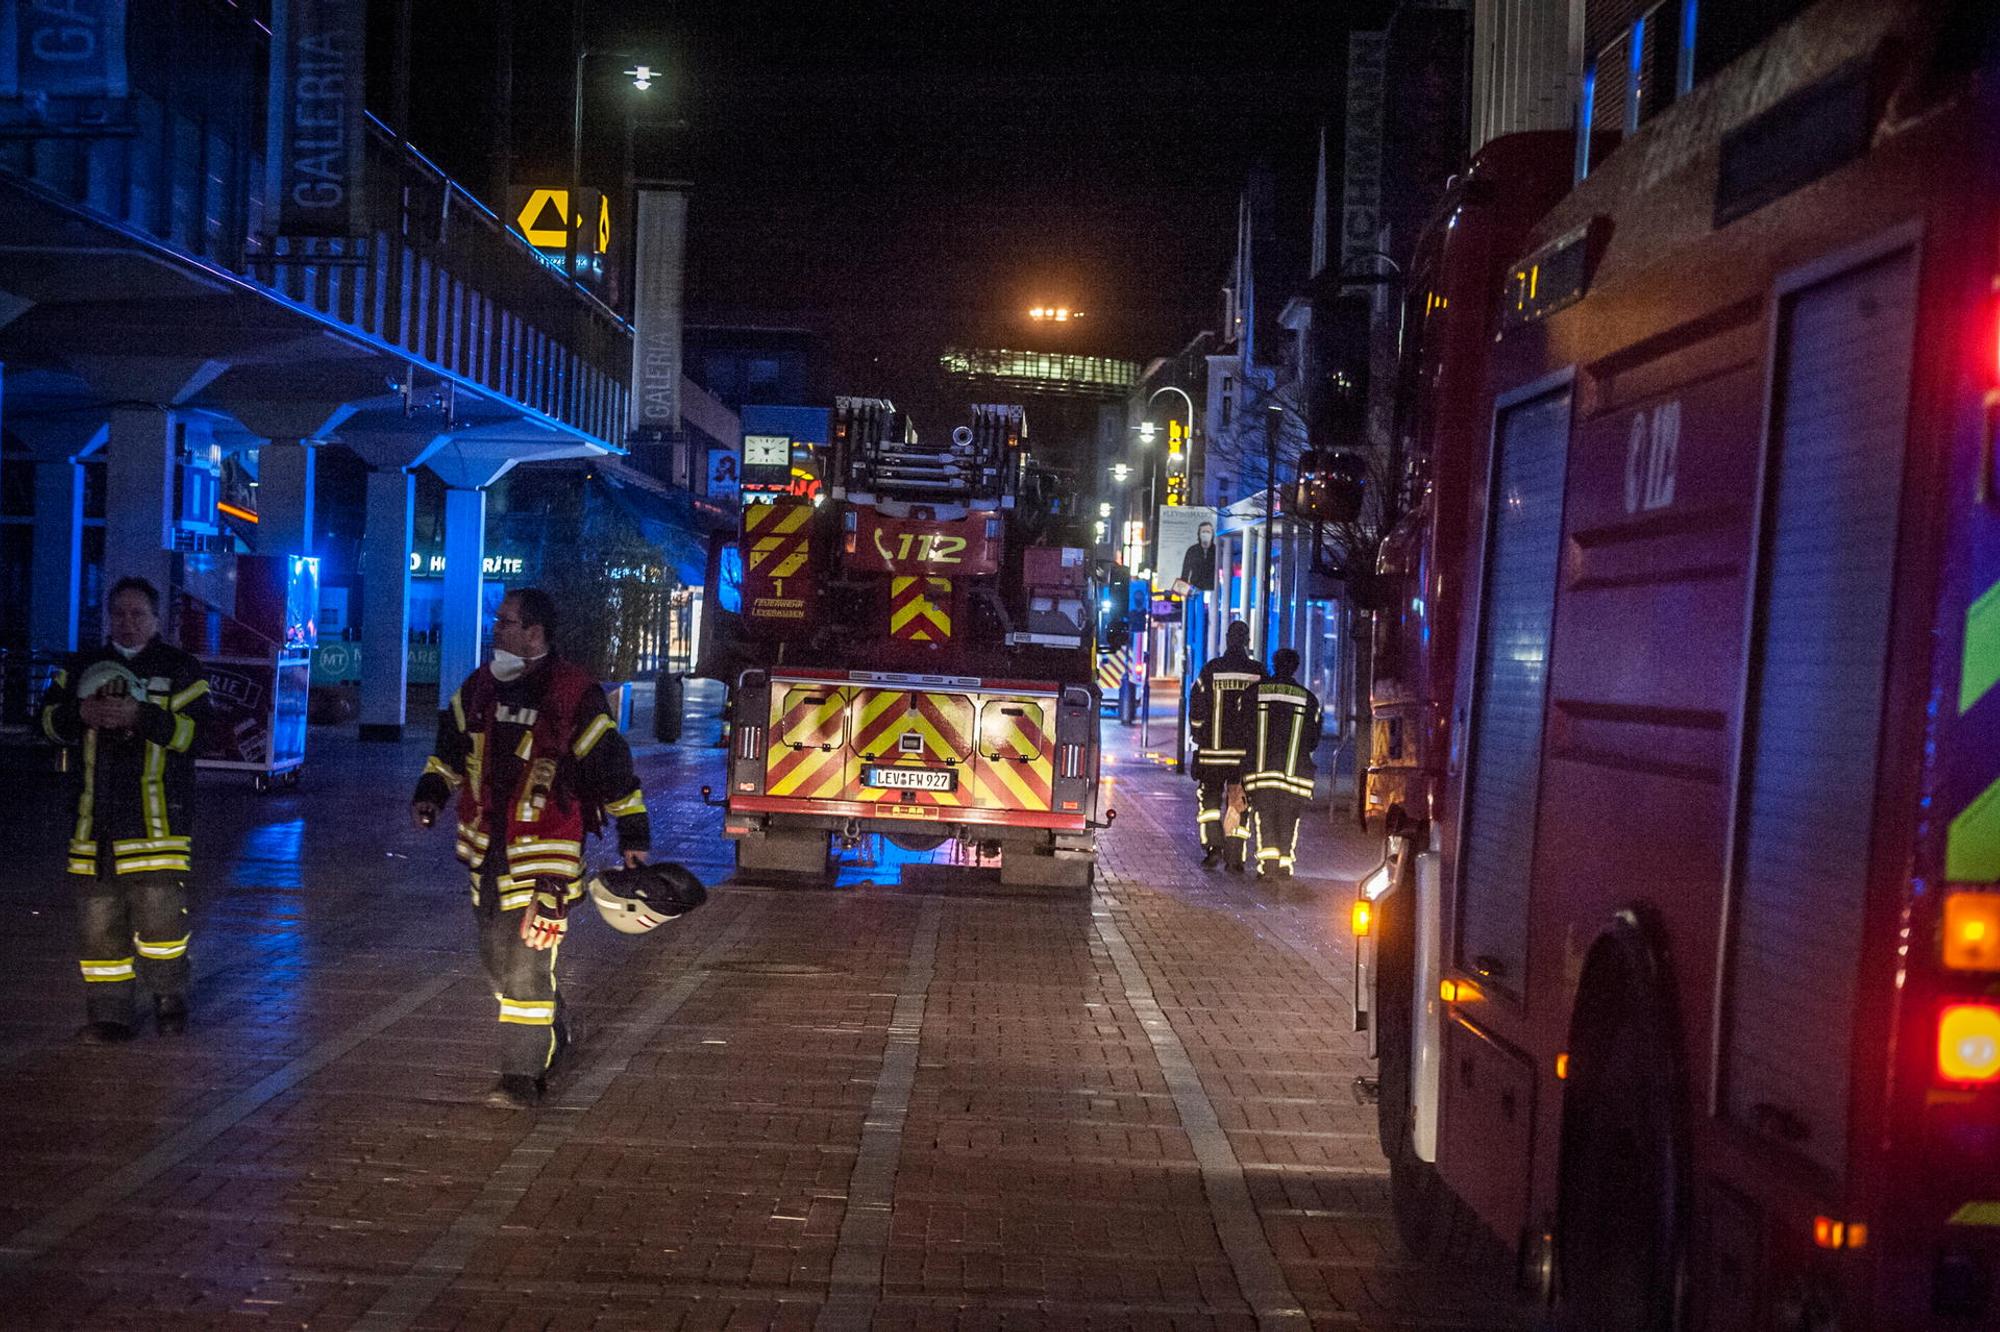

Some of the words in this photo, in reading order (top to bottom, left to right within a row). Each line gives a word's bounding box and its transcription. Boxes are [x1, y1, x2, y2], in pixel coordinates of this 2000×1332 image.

[292, 30, 345, 208] GALERIA
[644, 331, 671, 419] GALERIA
[897, 533, 967, 563] 112
[772, 578, 782, 597] 1
[323, 653, 345, 665] MT
[209, 674, 241, 695] RIE
[877, 771, 900, 785] LEV
[908, 773, 923, 786] FW
[926, 774, 948, 788] 927
